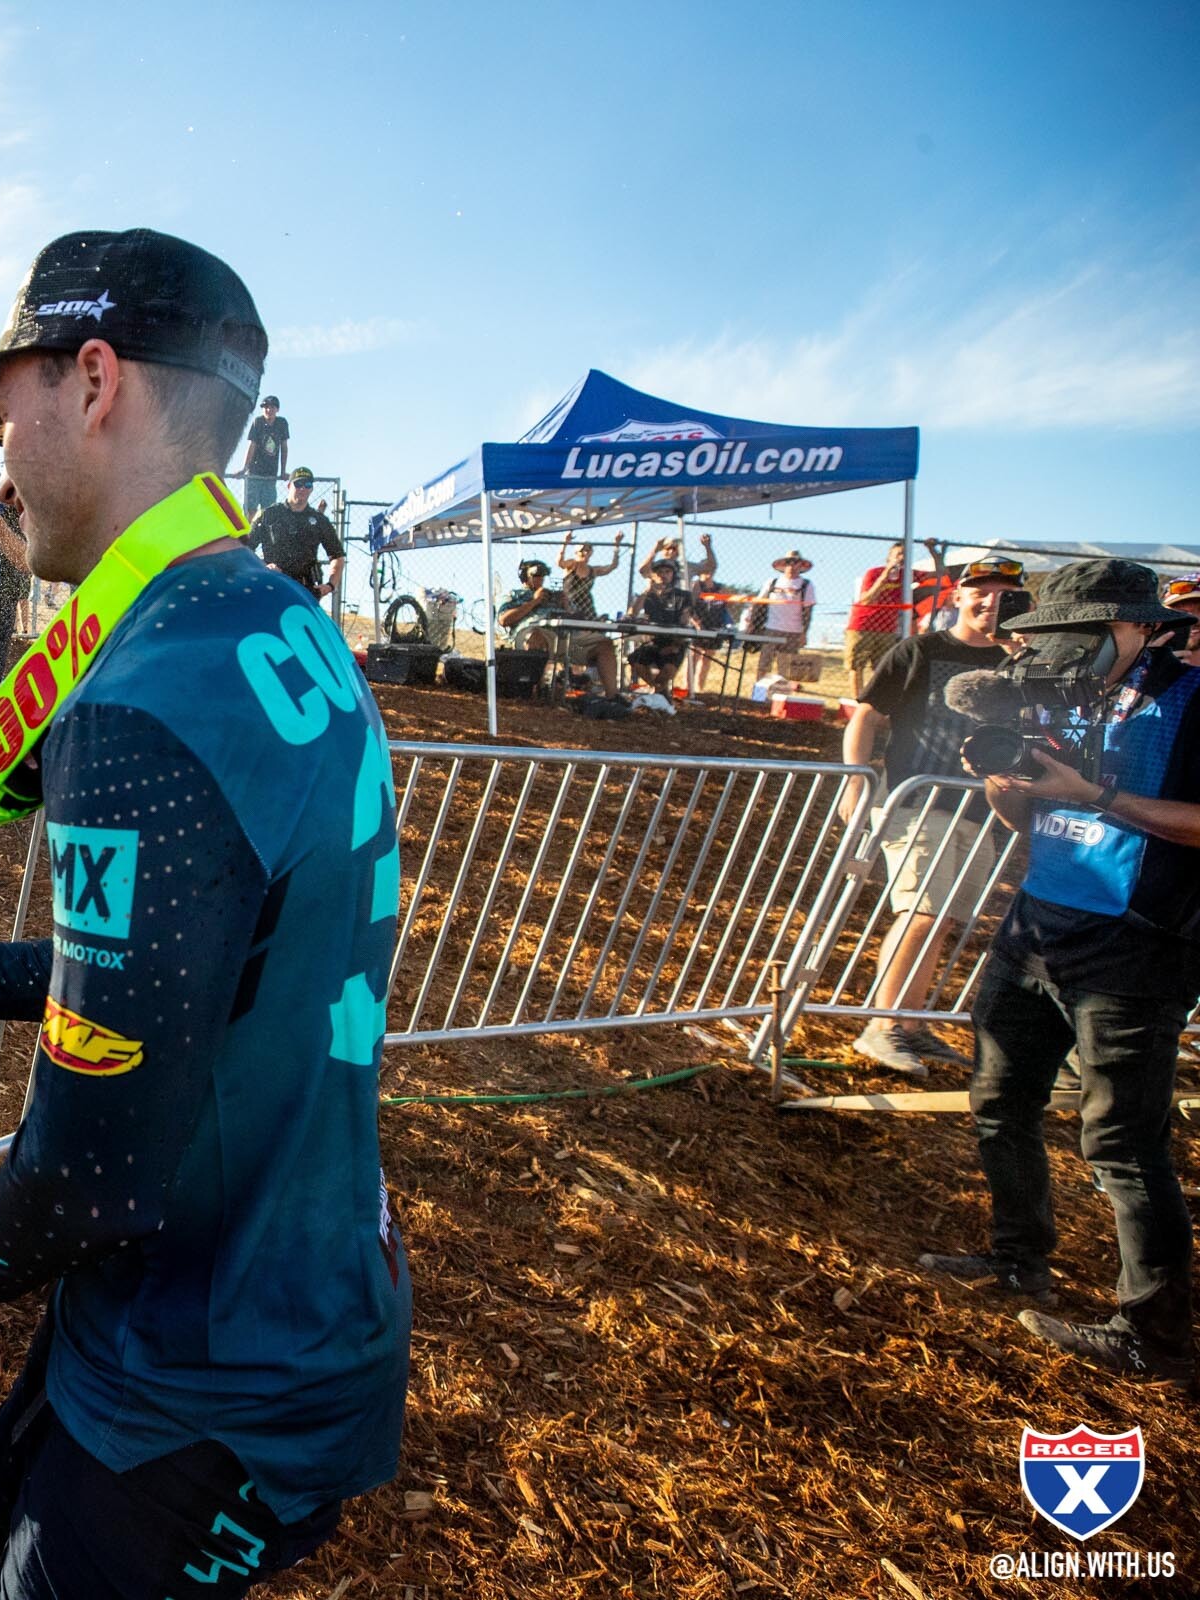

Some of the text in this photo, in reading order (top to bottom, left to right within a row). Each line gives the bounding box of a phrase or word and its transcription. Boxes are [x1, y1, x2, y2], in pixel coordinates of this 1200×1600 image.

[561, 442, 843, 479] LucasOil.com
[1033, 812, 1105, 847] VIDEO
[62, 945, 125, 970] MOTOX
[43, 1010, 144, 1065] MF
